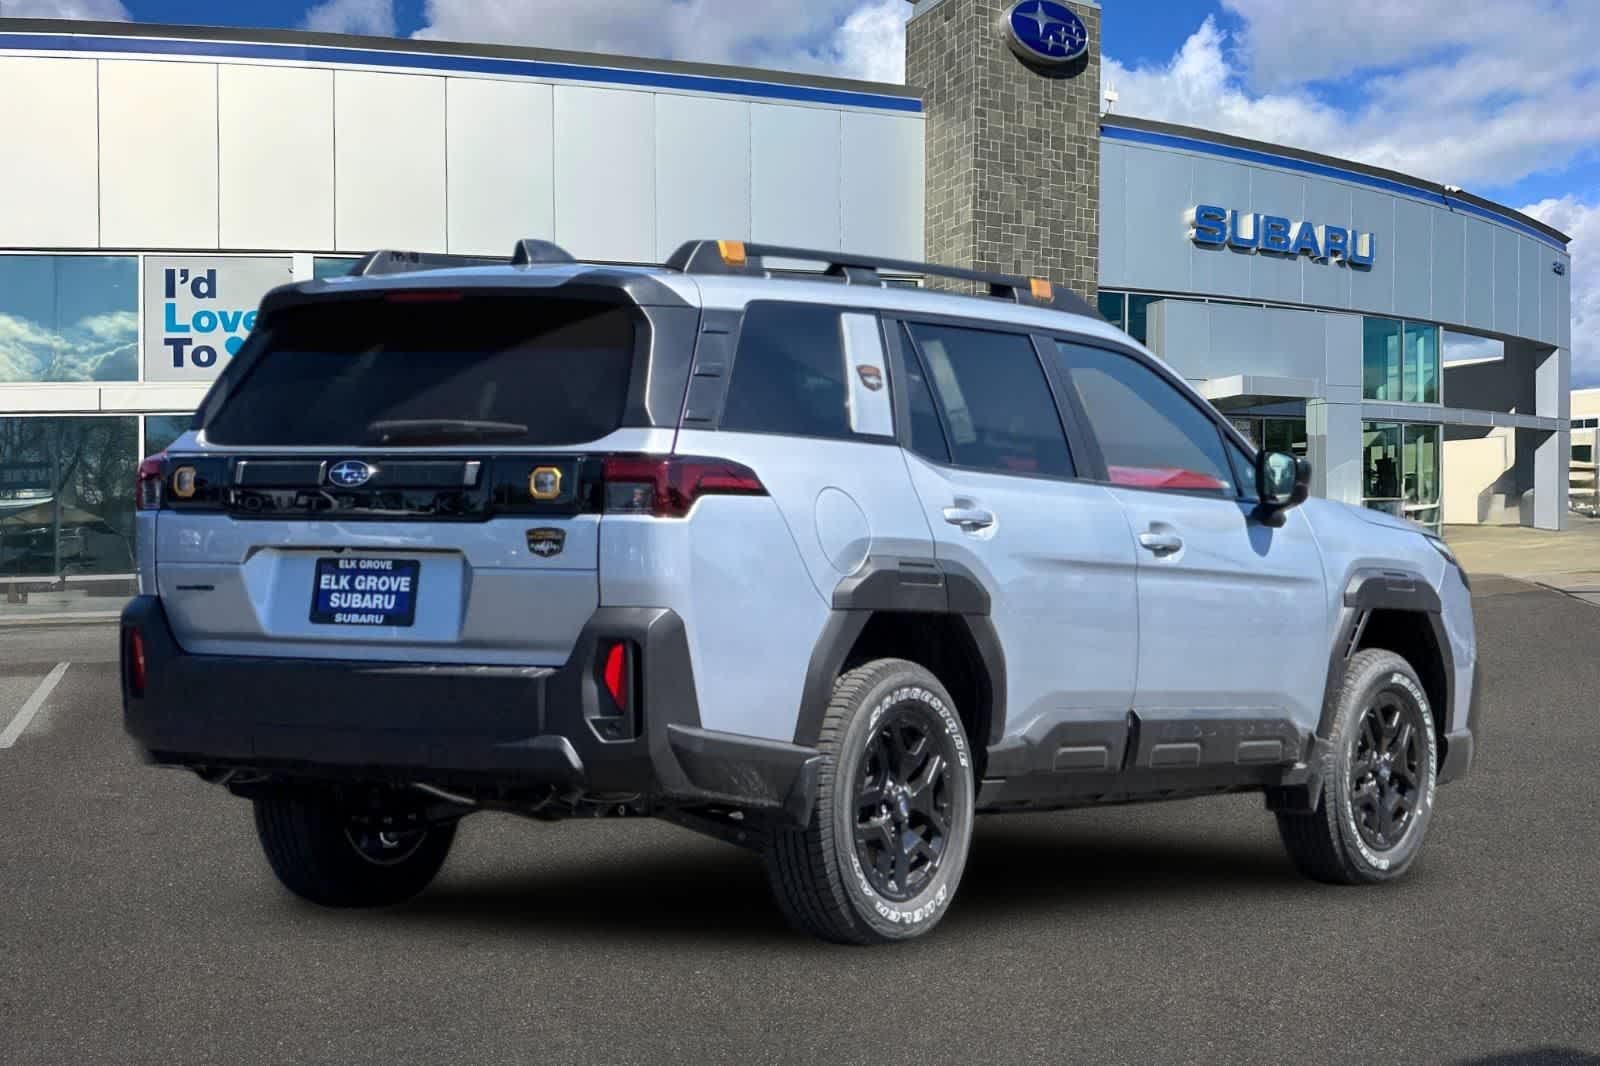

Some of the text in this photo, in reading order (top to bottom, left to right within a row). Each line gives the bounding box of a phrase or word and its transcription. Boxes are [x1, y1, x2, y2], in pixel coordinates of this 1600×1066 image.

[1190, 204, 1376, 270] SUBARU
[165, 268, 217, 299] I'd
[163, 337, 218, 368] To
[338, 559, 393, 570] ELK GROVE
[320, 574, 411, 592] ELK GROVE
[329, 592, 396, 609] SUBARU
[334, 612, 384, 624] SUBARU
